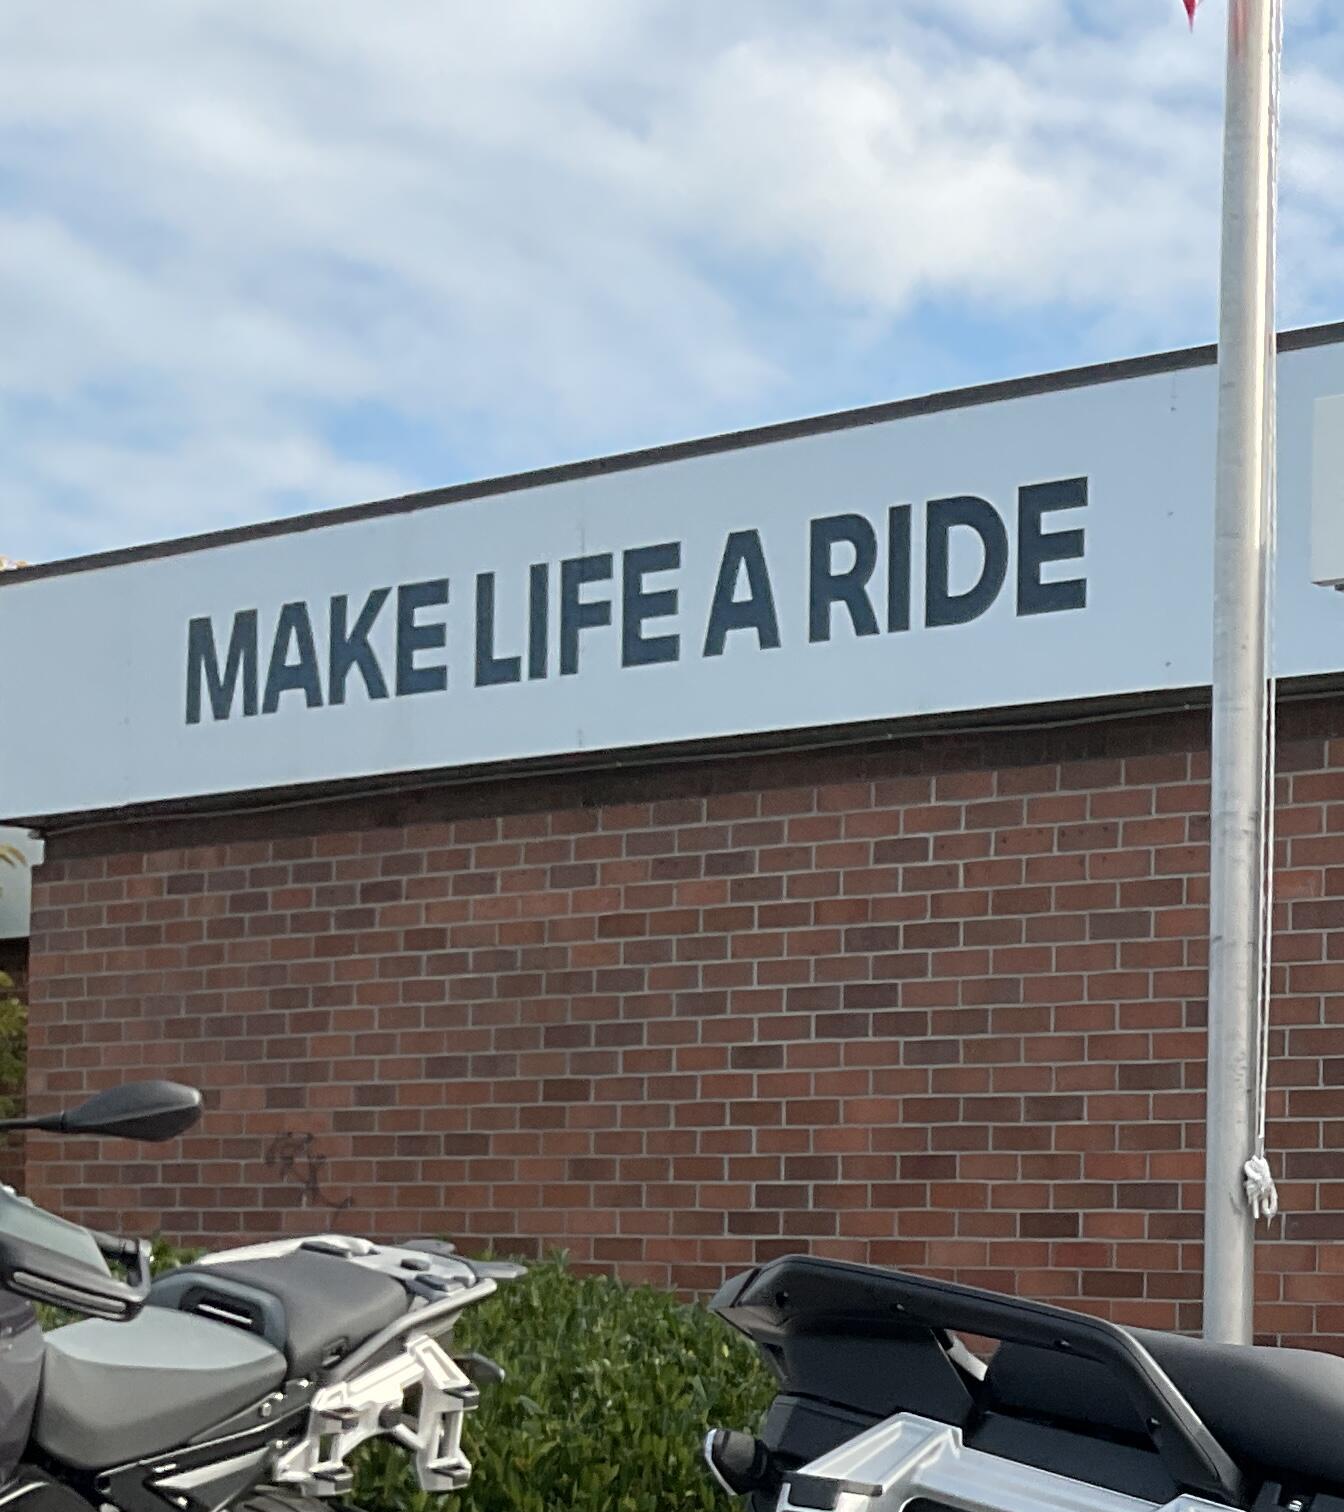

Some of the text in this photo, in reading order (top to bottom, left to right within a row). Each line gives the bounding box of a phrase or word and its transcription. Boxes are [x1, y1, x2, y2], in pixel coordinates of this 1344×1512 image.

[185, 476, 1089, 725] MAKE LIFE A RIDE
